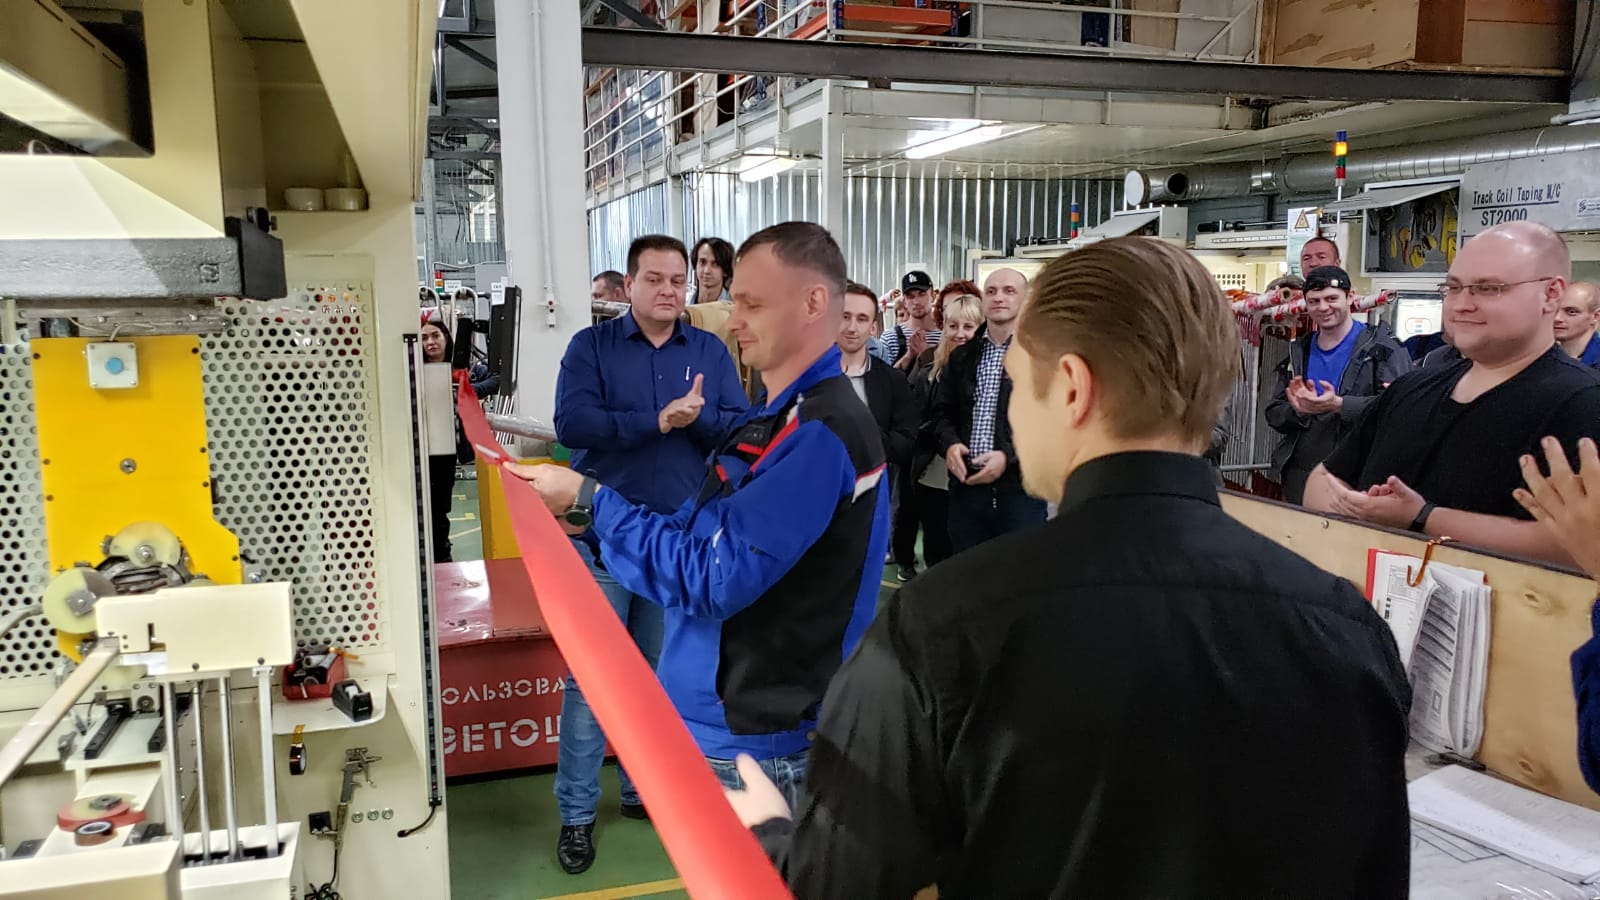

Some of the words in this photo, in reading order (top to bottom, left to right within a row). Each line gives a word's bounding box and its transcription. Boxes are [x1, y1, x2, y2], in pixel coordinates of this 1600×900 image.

[1473, 190, 1493, 205] Track
[1496, 188, 1513, 203] Coil
[1517, 185, 1543, 201] Taping
[1481, 208, 1528, 226] ST2000
